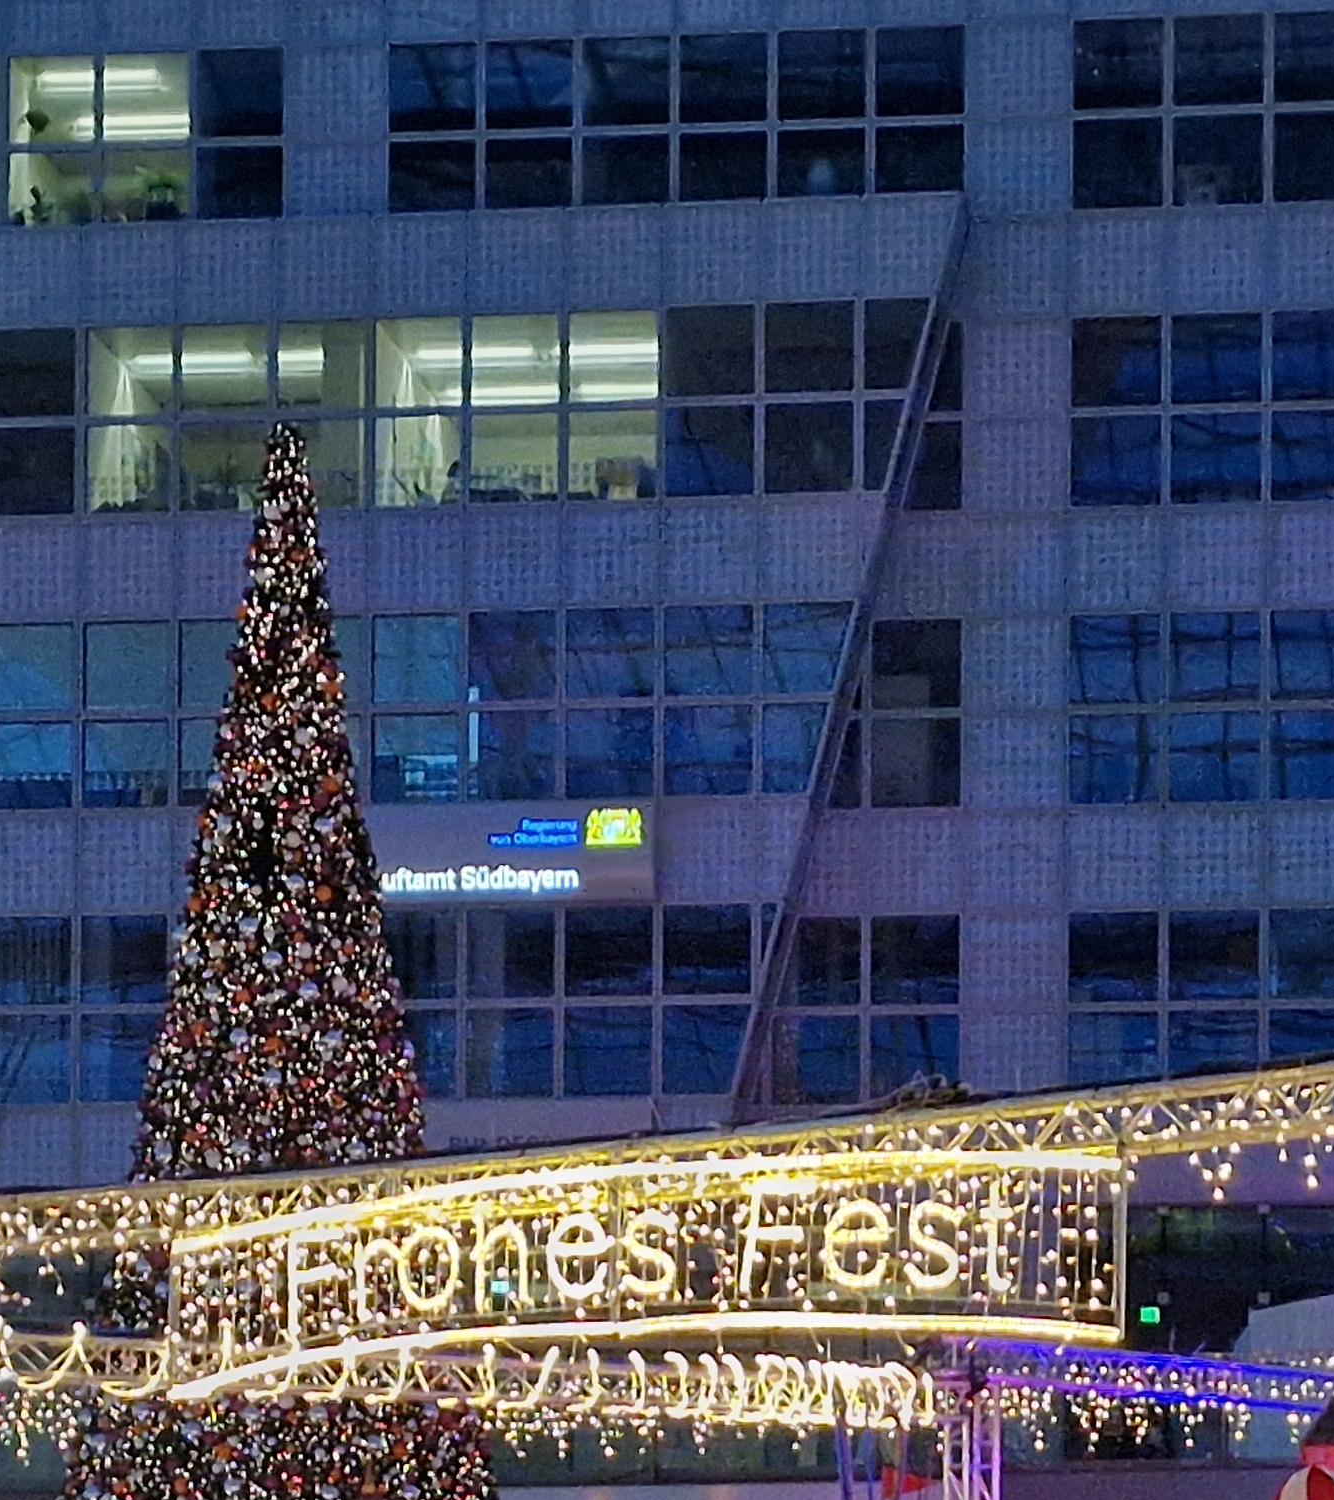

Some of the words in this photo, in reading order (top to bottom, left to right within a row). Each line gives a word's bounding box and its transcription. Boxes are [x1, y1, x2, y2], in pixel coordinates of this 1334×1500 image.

[381, 866, 457, 891] uftamt
[460, 864, 580, 892] Südbayern
[737, 1172, 1015, 1292] Fest
